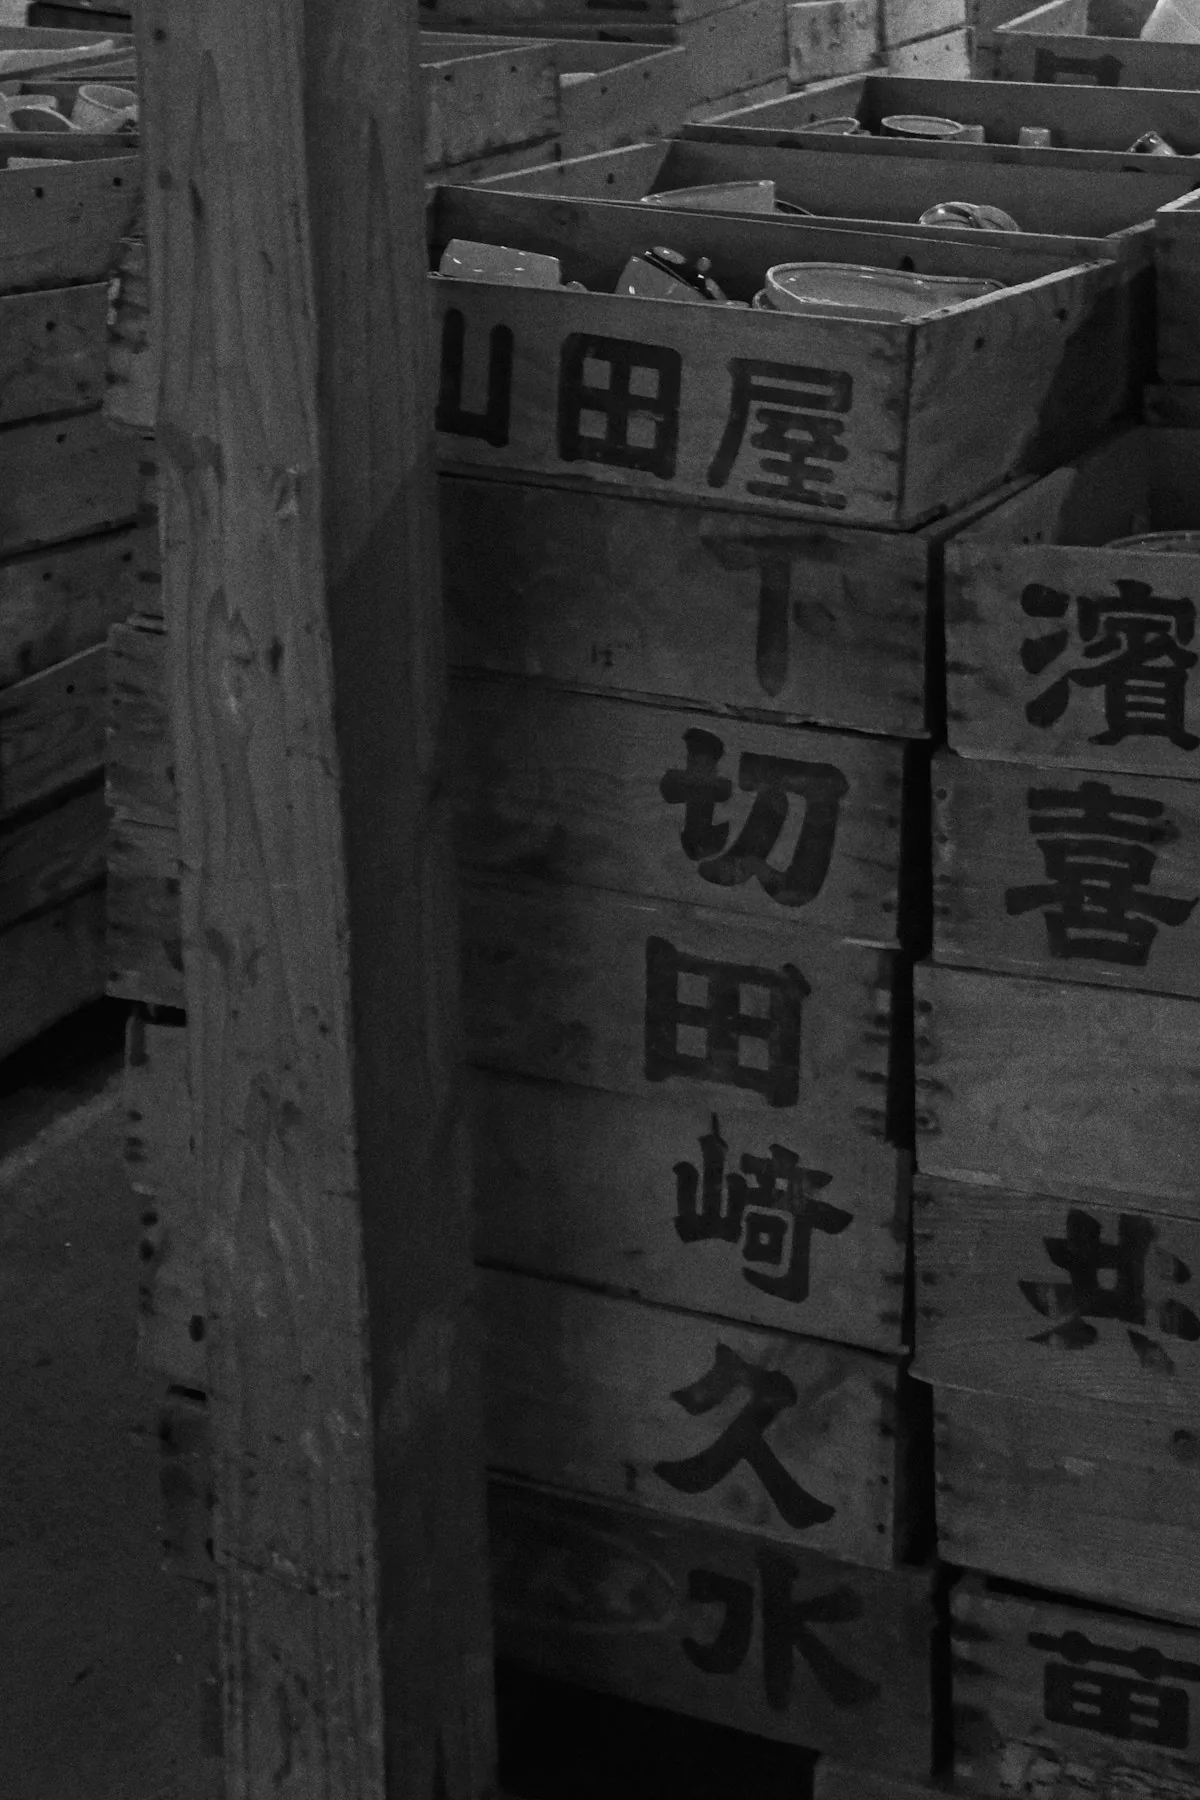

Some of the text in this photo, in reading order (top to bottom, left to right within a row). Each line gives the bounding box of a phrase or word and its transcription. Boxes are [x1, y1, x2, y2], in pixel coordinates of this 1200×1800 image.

[660, 727, 849, 908] 切
[1005, 780, 1200, 967] 喜
[644, 935, 812, 1108] 田
[654, 1341, 837, 1530] 久
[681, 1546, 880, 1711] 水
